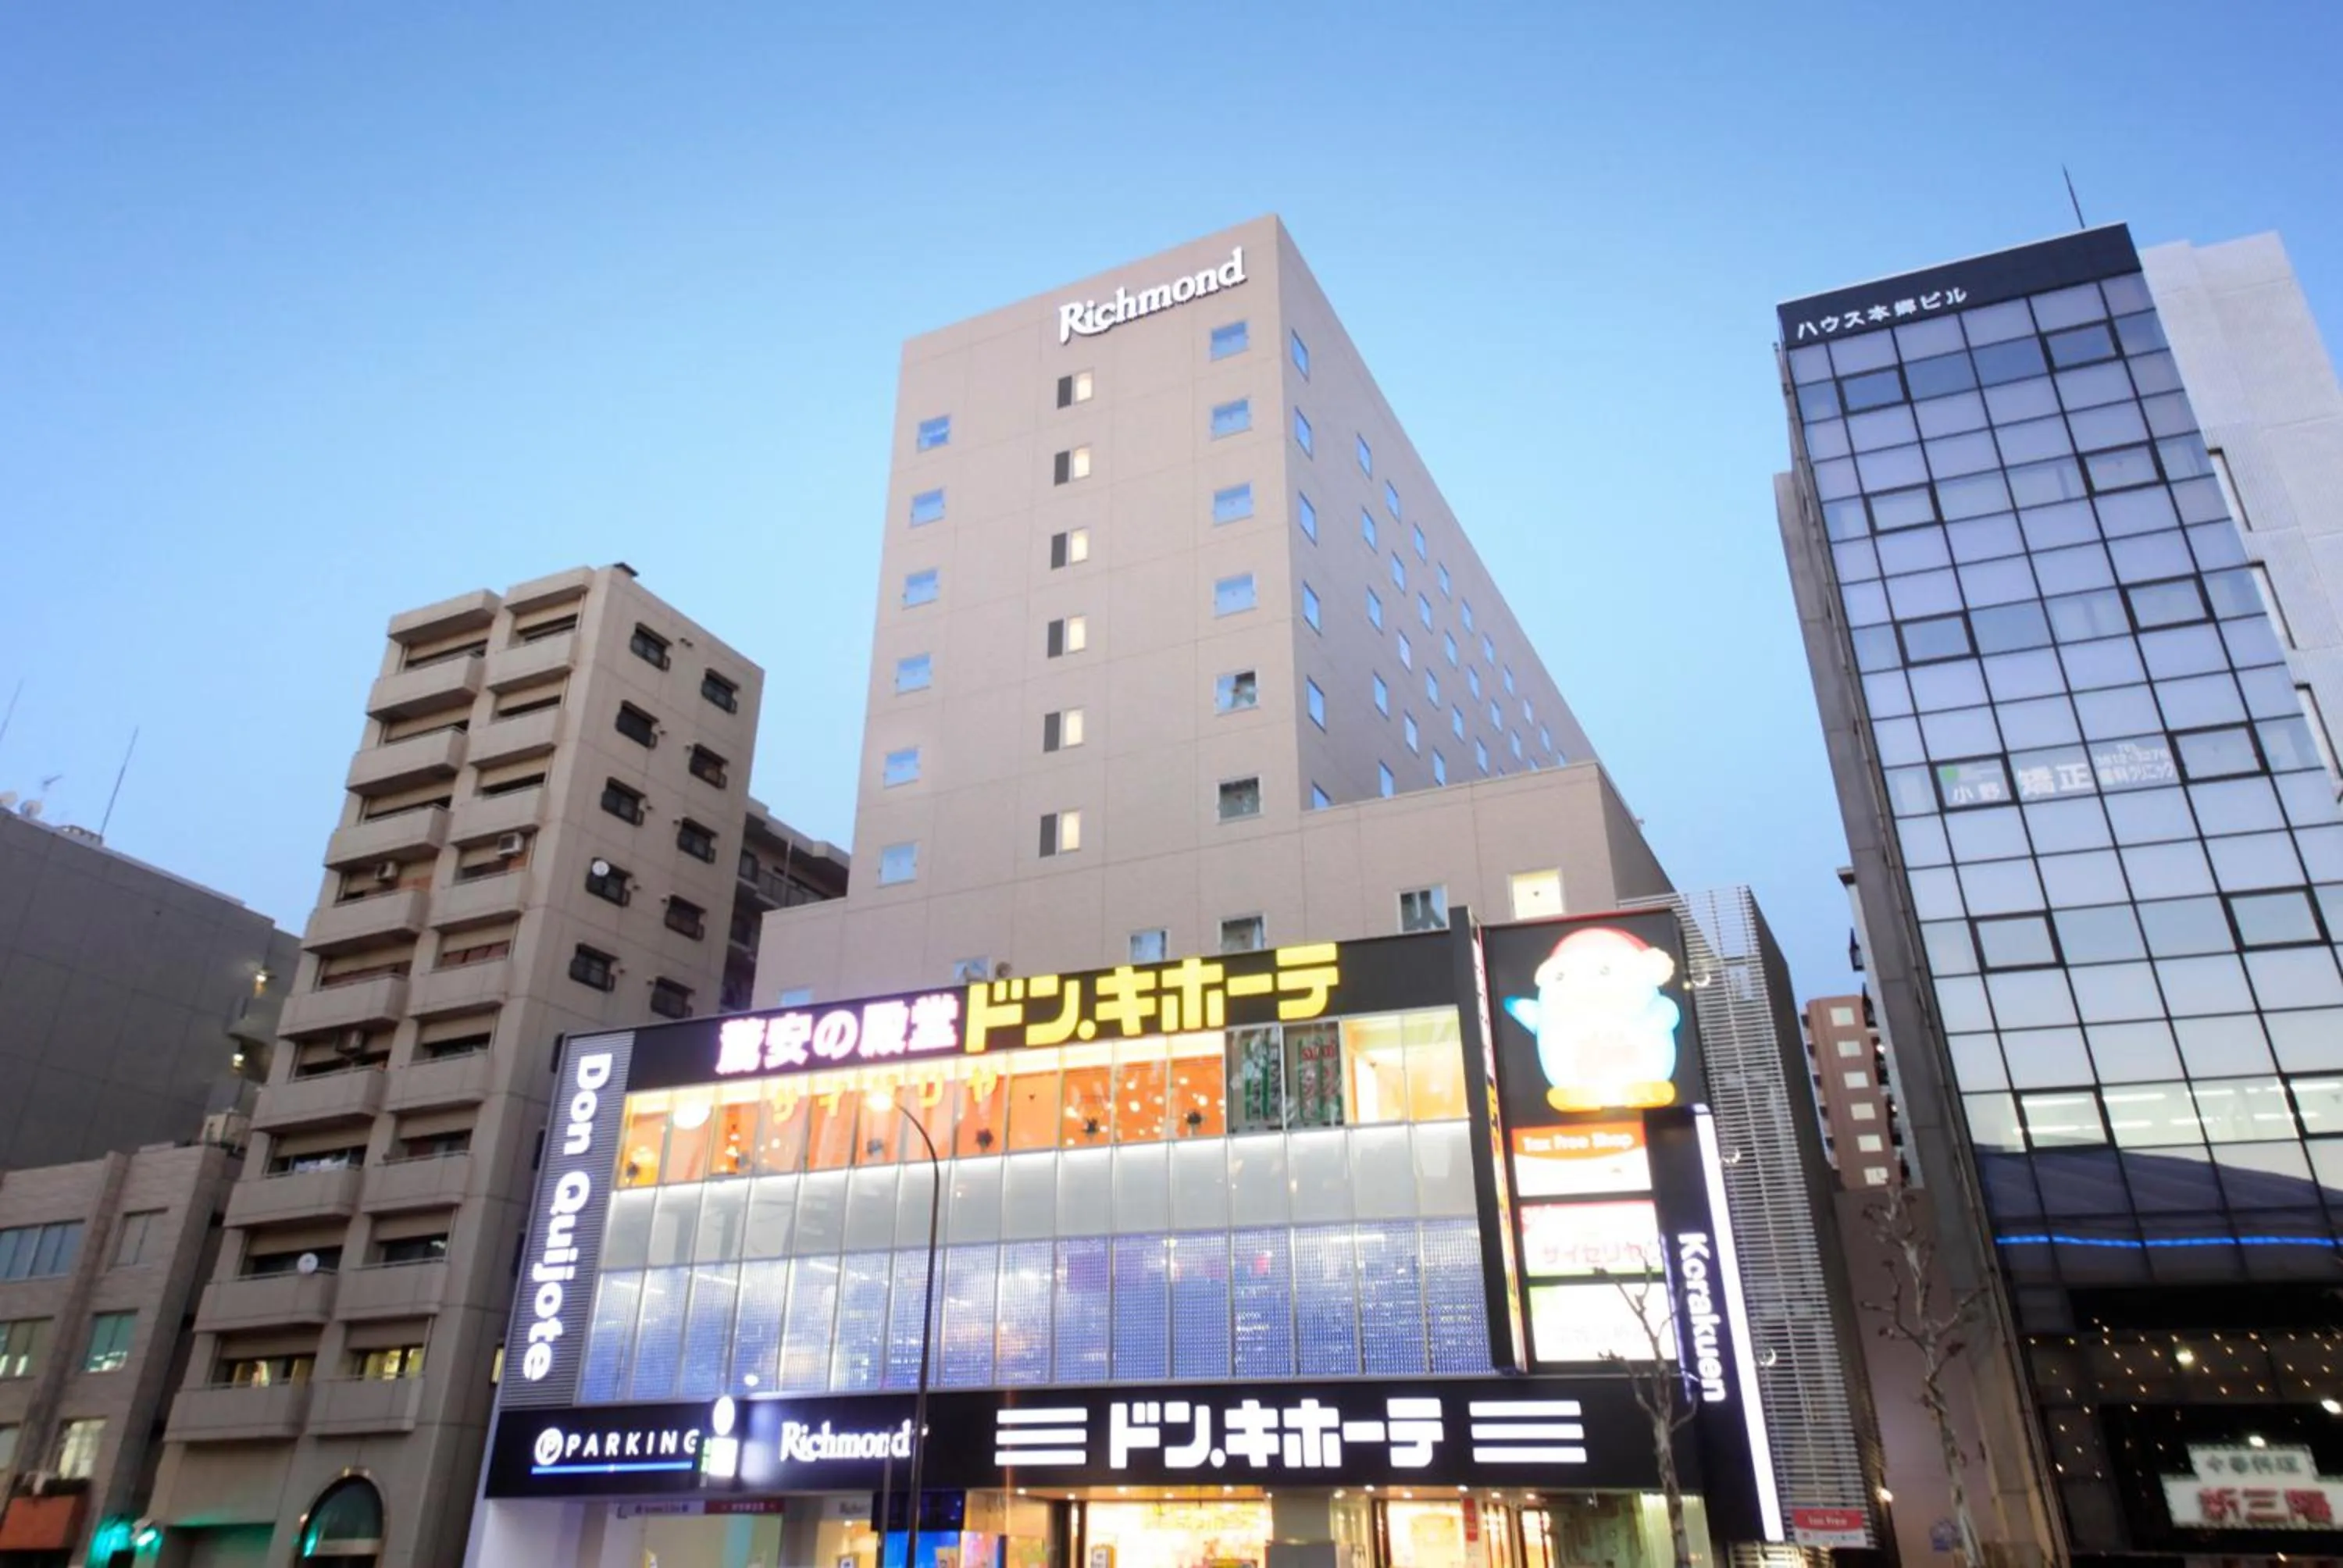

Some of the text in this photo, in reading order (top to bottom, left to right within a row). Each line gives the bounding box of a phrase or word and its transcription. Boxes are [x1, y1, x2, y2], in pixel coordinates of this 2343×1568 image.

[1059, 246, 1246, 344] Richmond
[716, 995, 958, 1073] 驚安の殿堂
[1553, 1134, 1590, 1149] Free
[1591, 1131, 1634, 1149] Shop
[522, 1053, 612, 1381] Don Quijote
[1677, 1232, 1726, 1403] Korakuen
[565, 1428, 701, 1457] PARKING
[779, 1418, 915, 1463] Richmond
